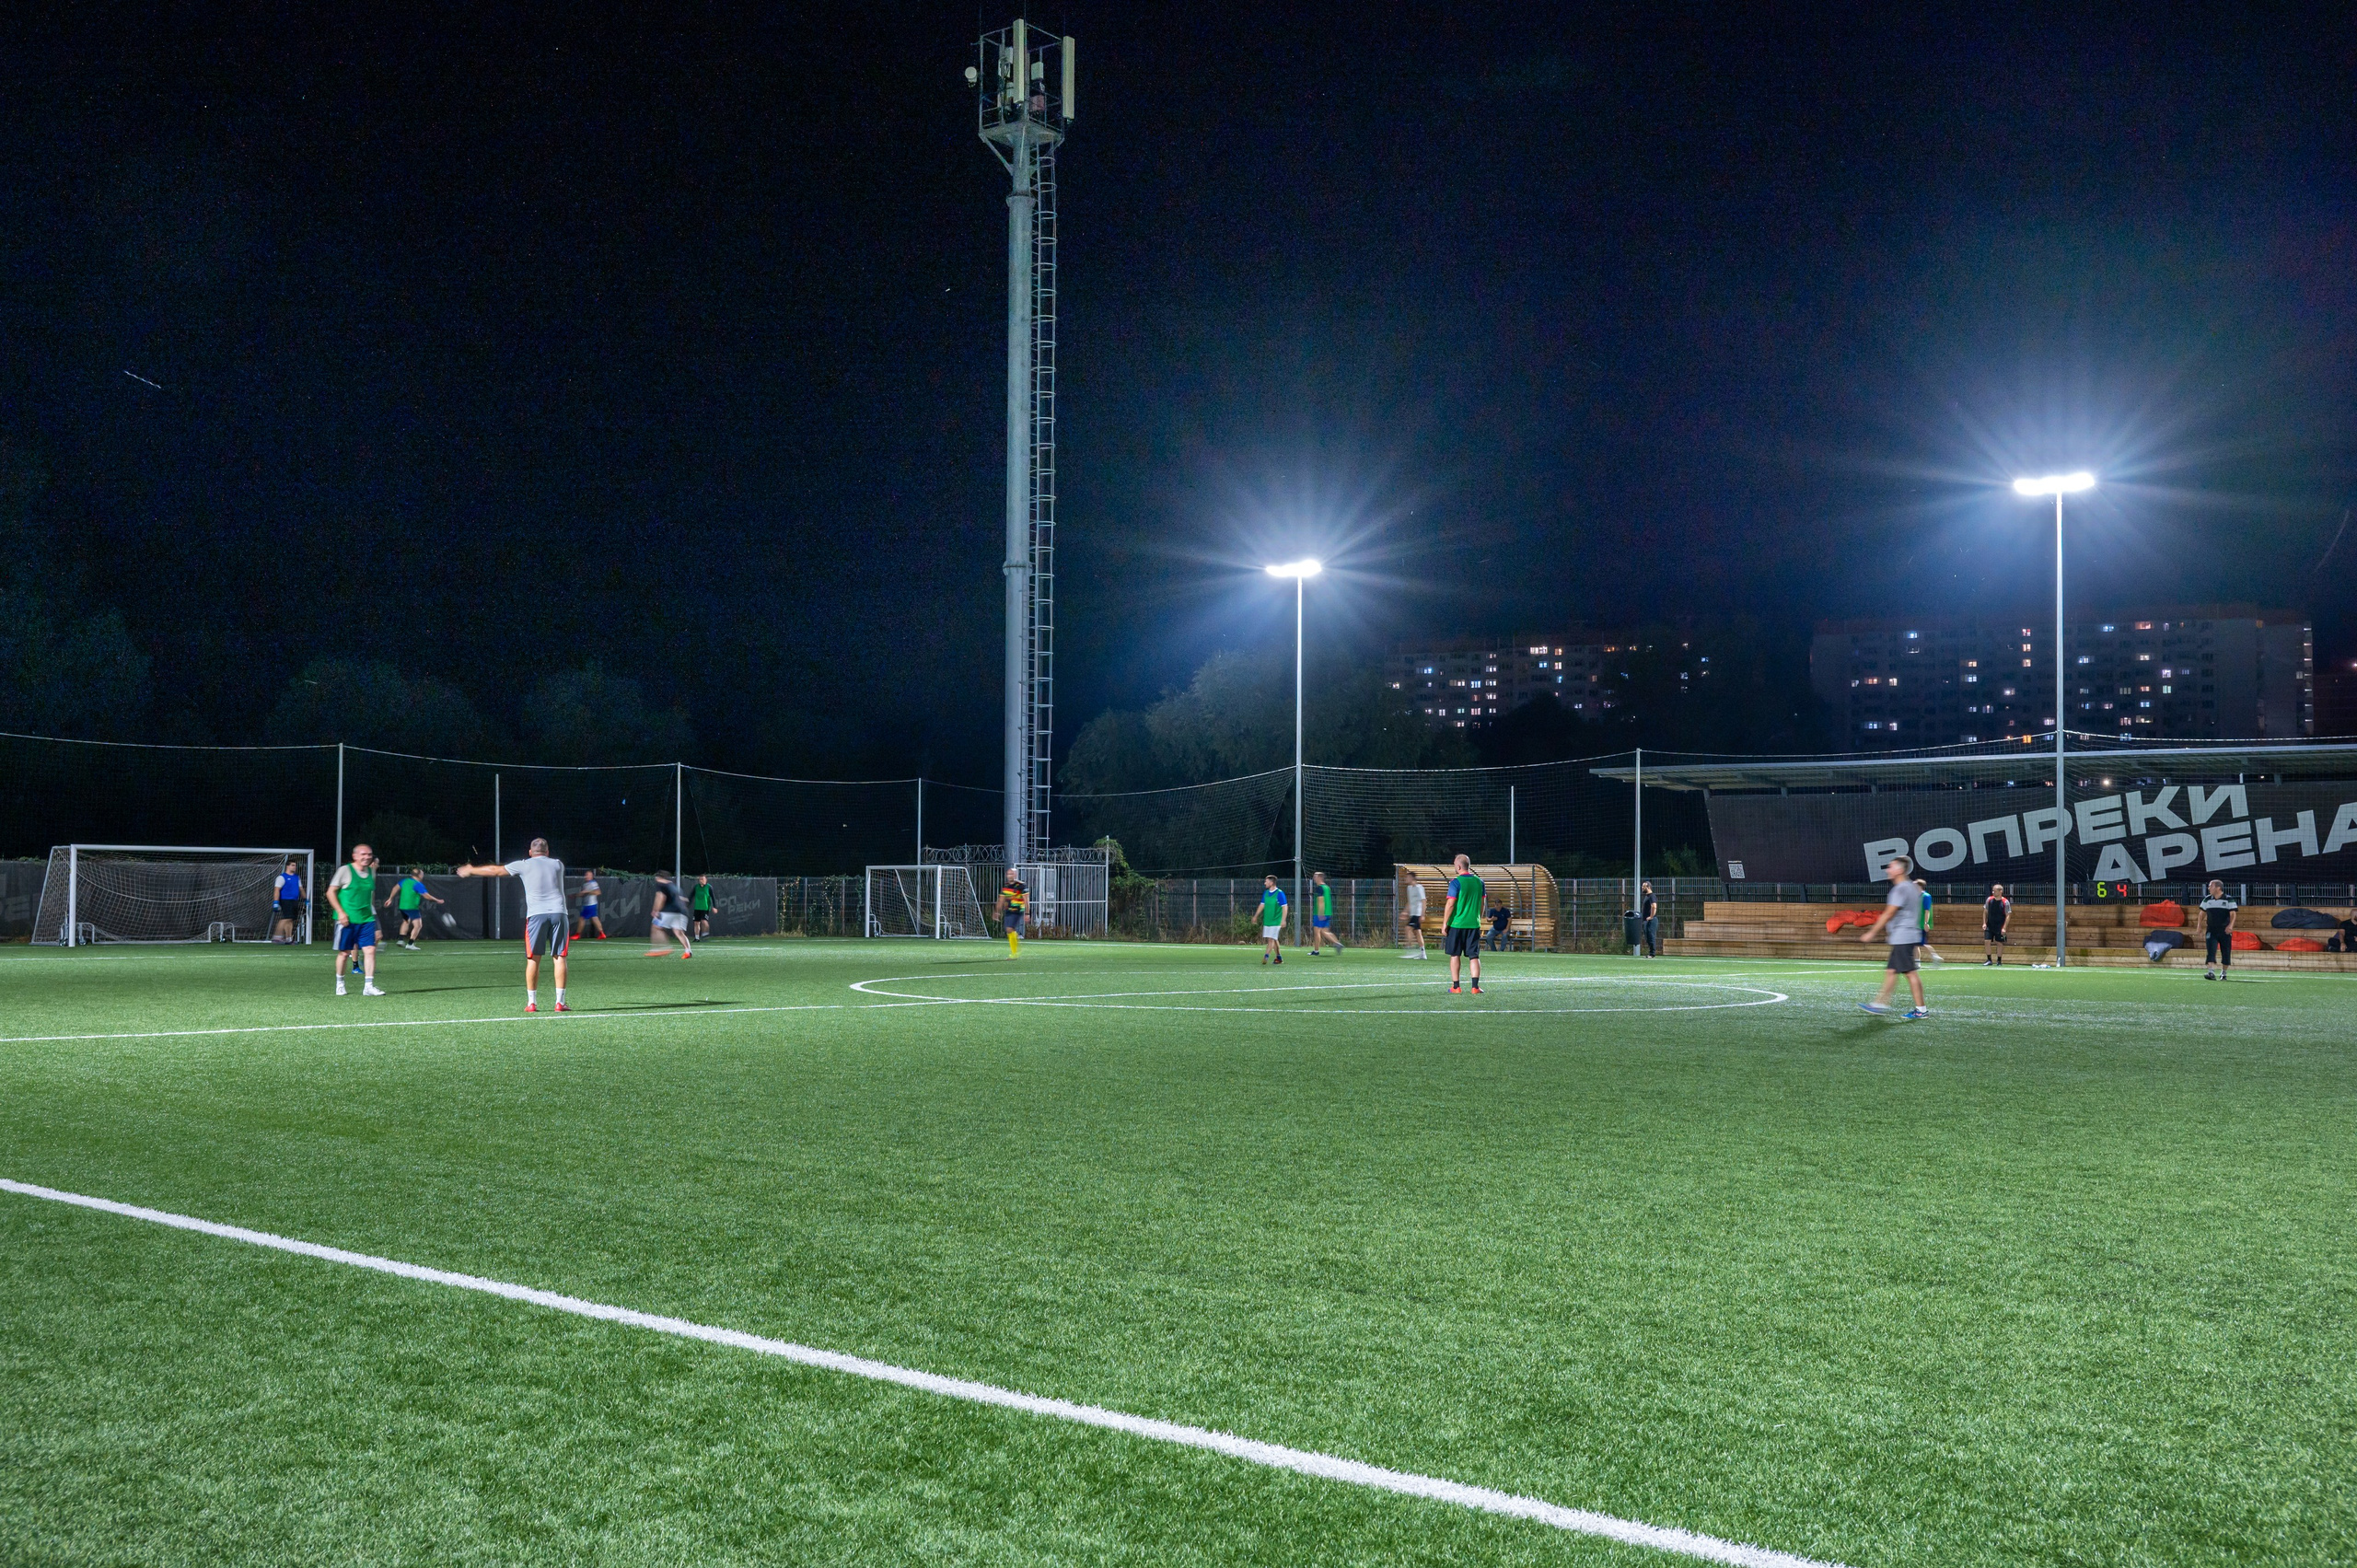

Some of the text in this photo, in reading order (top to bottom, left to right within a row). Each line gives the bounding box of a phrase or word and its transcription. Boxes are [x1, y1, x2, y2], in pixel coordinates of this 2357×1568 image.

[1864, 784, 2248, 882] ВОПРЕКИ
[2093, 802, 2357, 884] АРЕНА
[2096, 881, 2128, 899] 6 4
